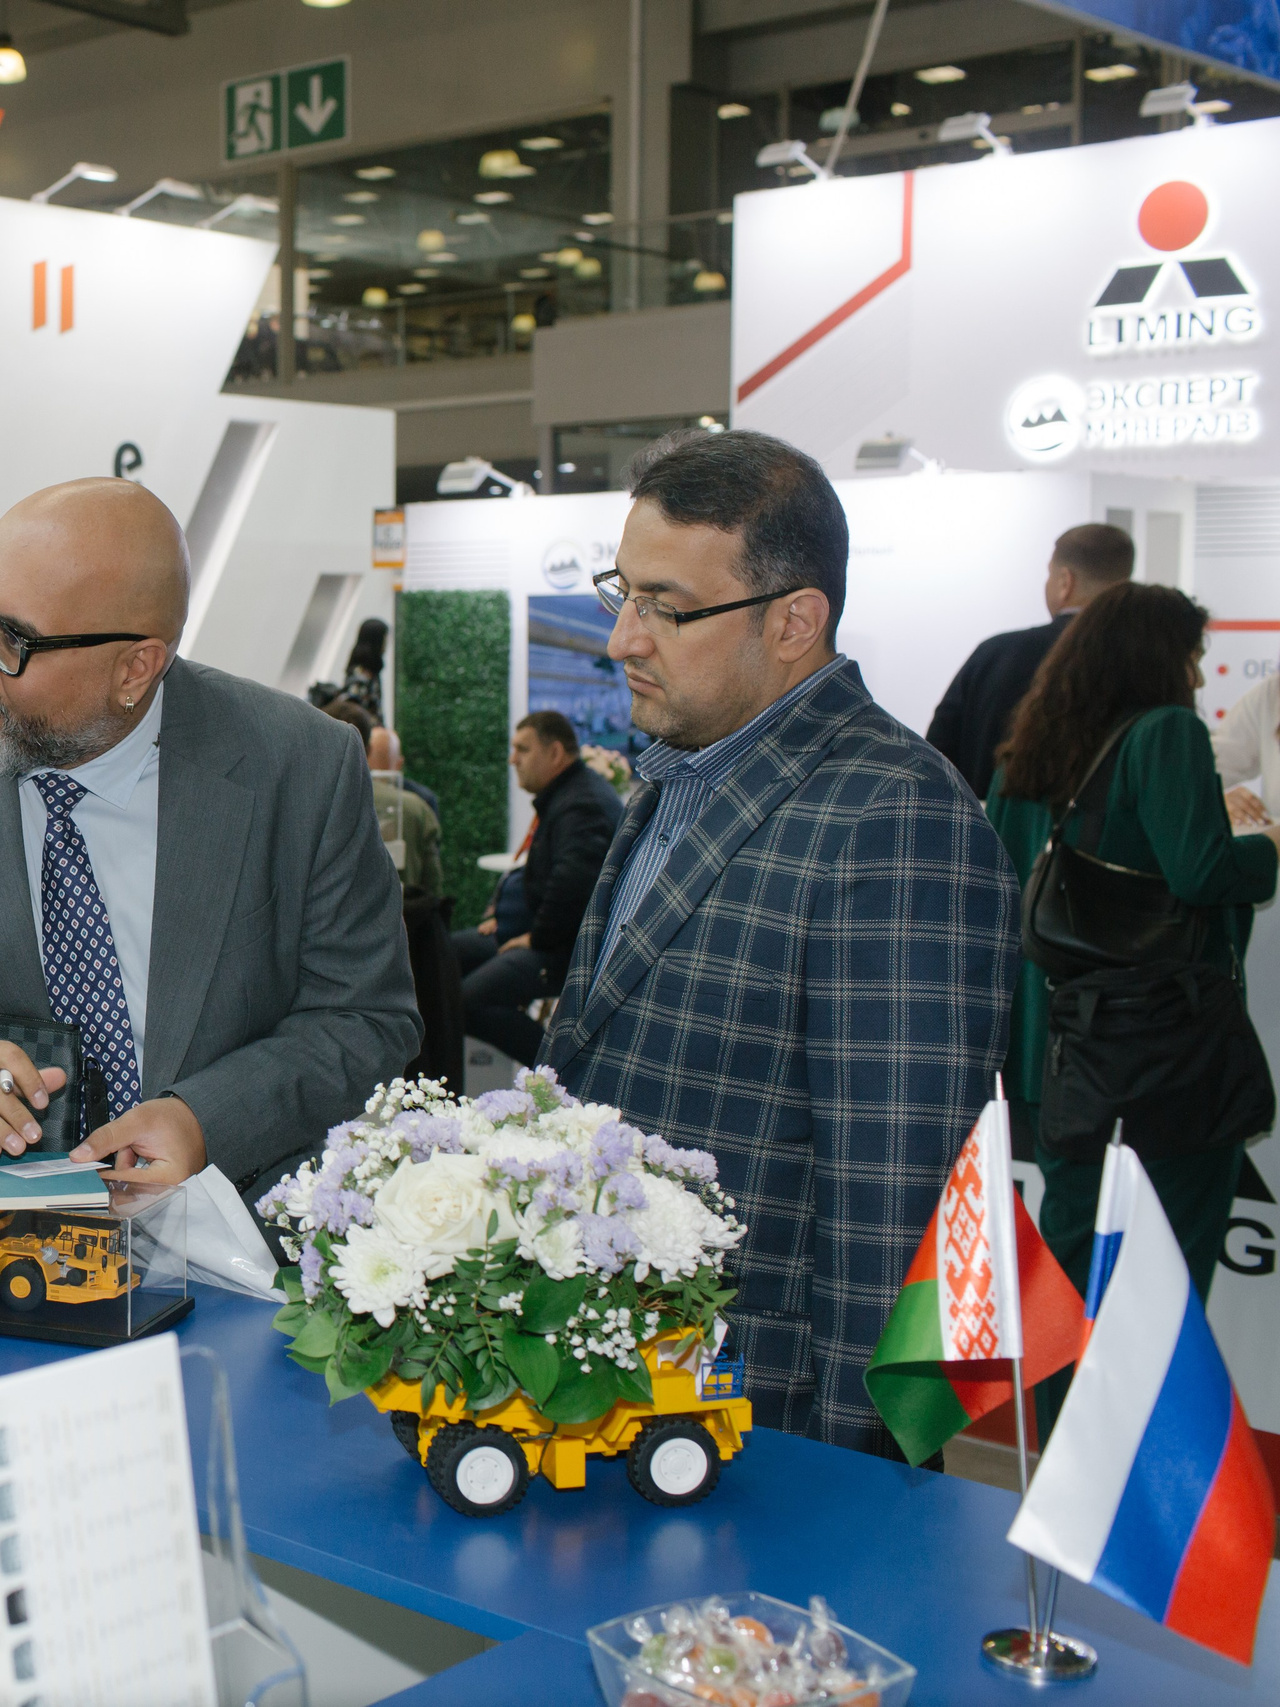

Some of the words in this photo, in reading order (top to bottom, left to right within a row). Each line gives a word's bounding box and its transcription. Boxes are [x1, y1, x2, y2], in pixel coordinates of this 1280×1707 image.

[1088, 305, 1256, 346] LIMING
[1086, 374, 1256, 411] ЭКСПЕРТ
[1219, 1217, 1276, 1276] G
